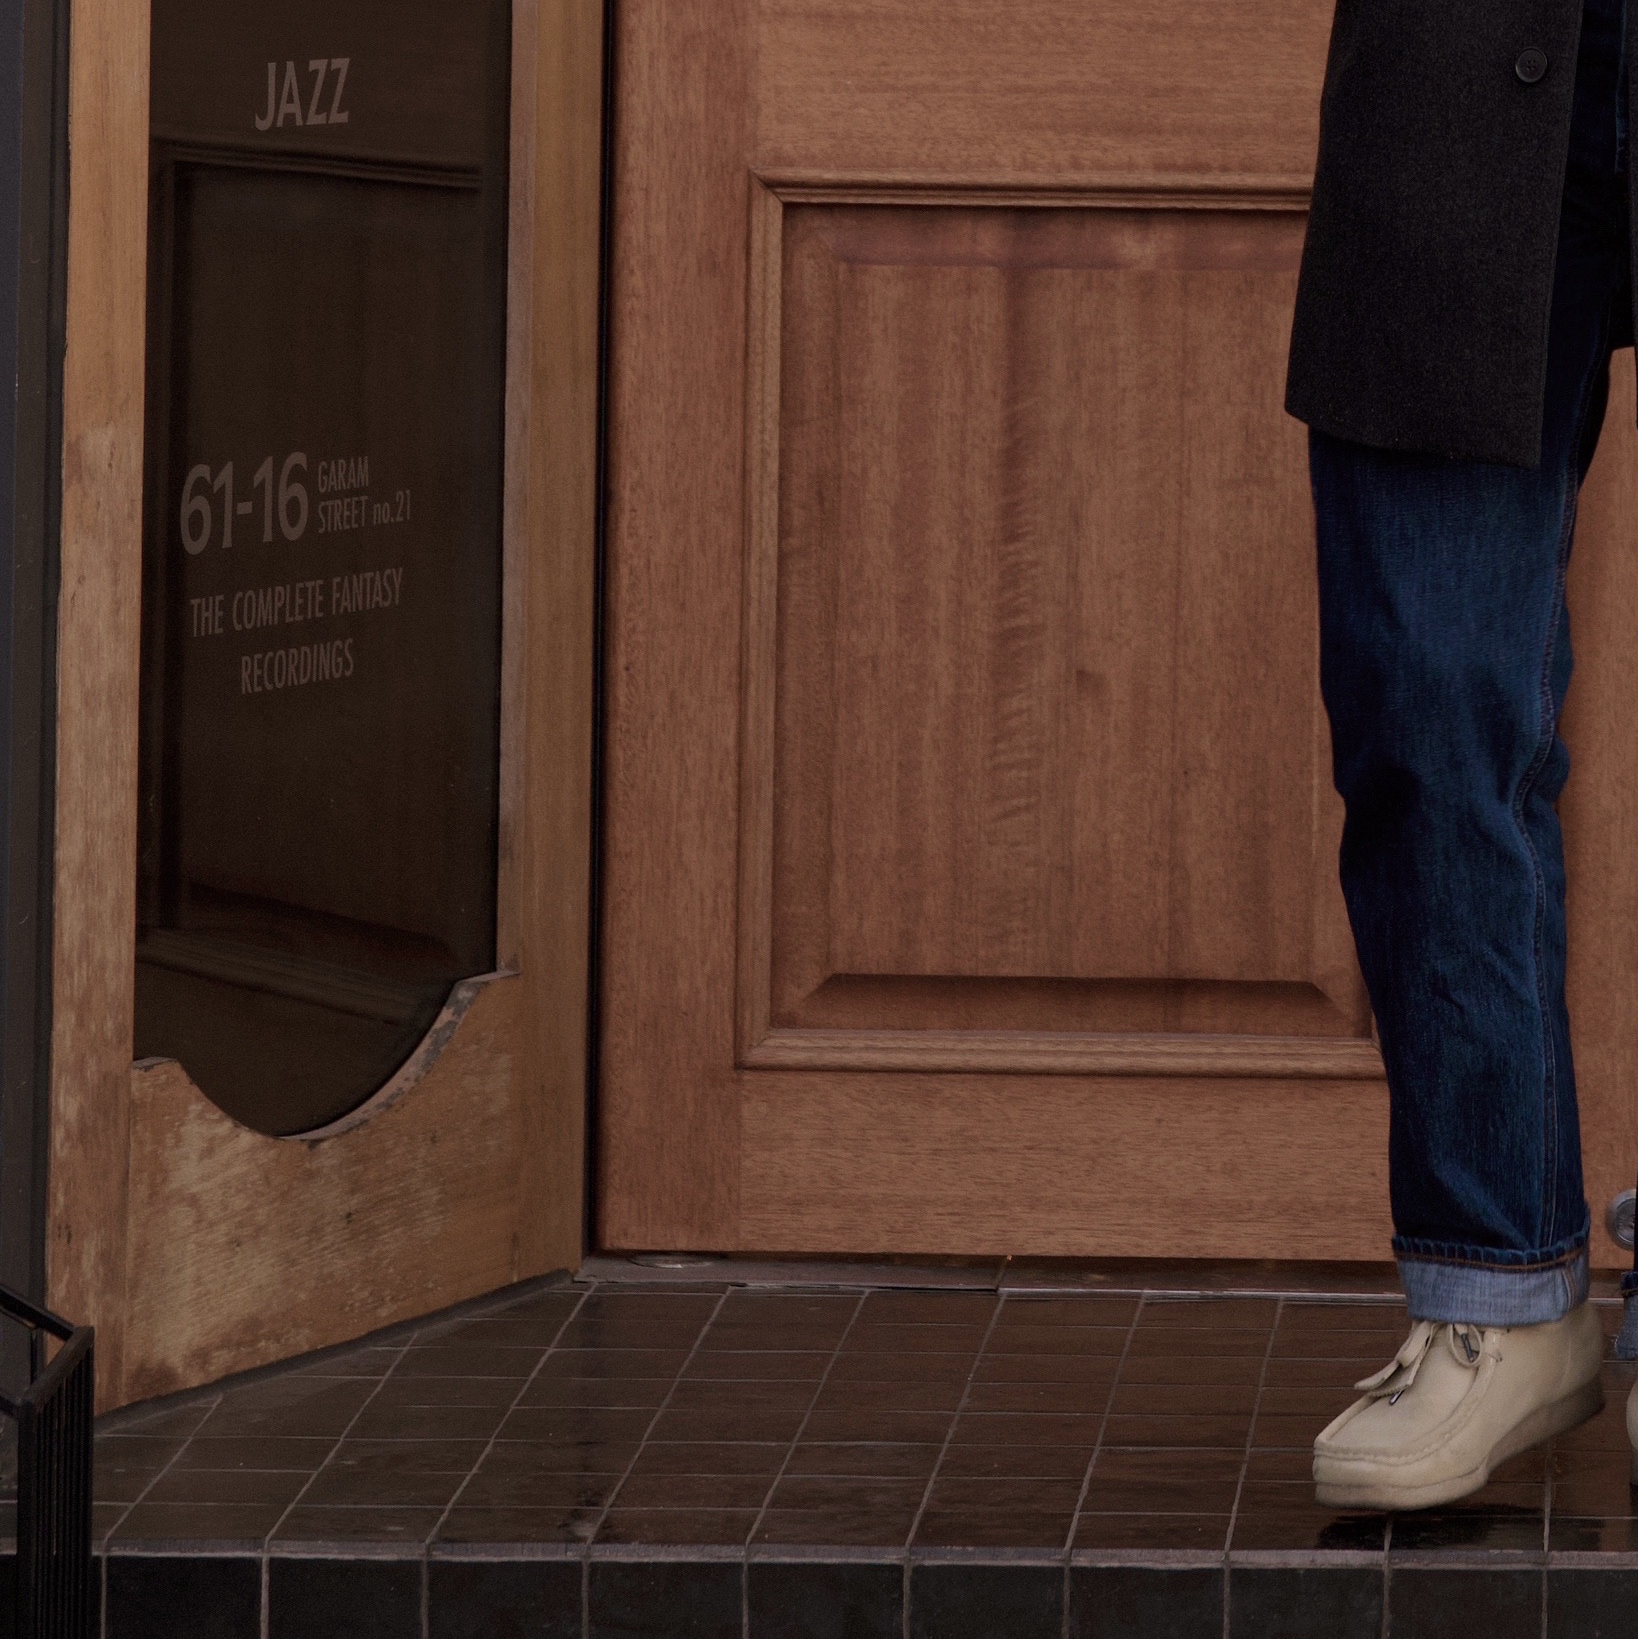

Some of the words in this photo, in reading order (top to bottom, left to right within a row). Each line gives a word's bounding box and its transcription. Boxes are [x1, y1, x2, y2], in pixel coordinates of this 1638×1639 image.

[255, 57, 351, 132] JAZZ
[180, 451, 309, 556] 61-16
[318, 455, 369, 494] GARAM
[318, 495, 370, 534] STREET
[190, 594, 225, 638] THE
[233, 579, 325, 632] COMPLETE
[332, 567, 405, 616] FANTASY
[241, 638, 355, 695] RECORDINGS
